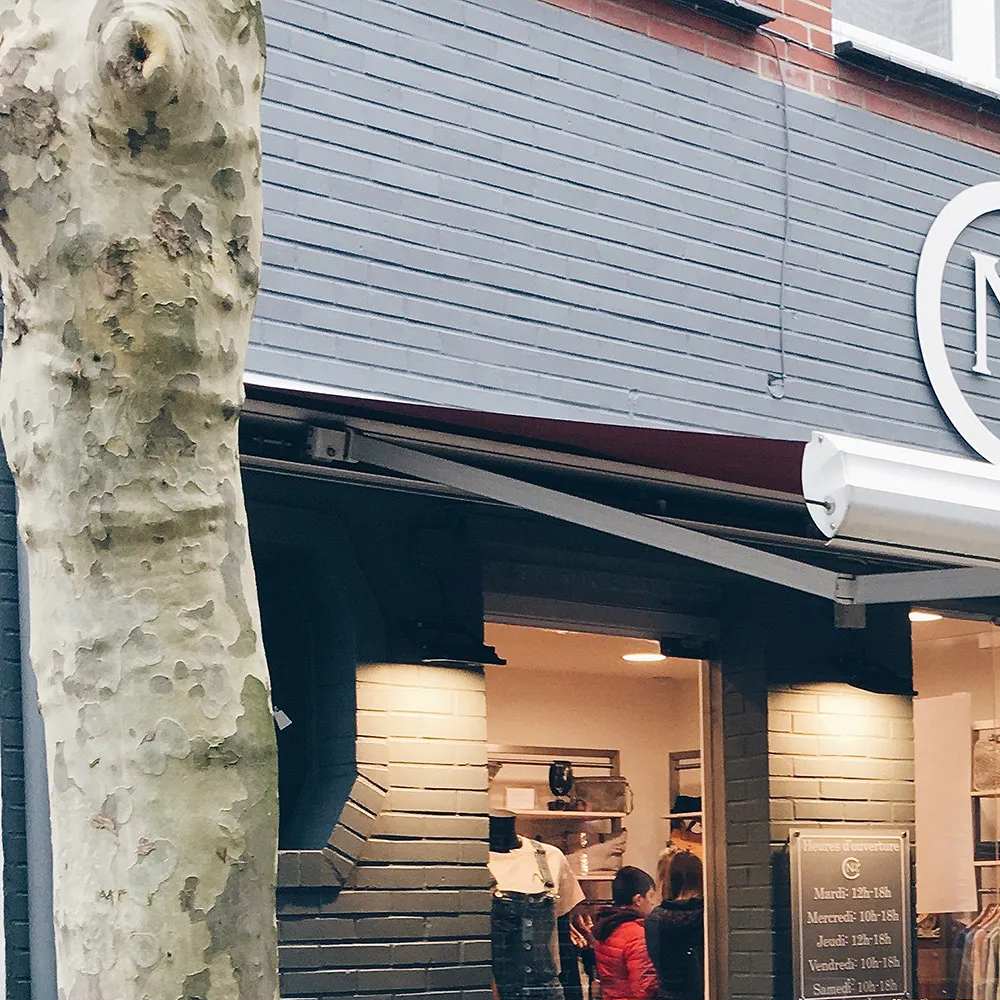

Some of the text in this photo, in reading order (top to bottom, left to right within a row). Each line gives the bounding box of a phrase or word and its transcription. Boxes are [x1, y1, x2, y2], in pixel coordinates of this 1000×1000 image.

[803, 839, 900, 852] Heures d'ouverture
[851, 886, 892, 899] 12h-18h
[859, 909, 900, 923] 10h-18h
[851, 933, 892, 946] 12h-18h
[860, 956, 901, 970] 10h-18h
[857, 979, 898, 994] 10h-18h
